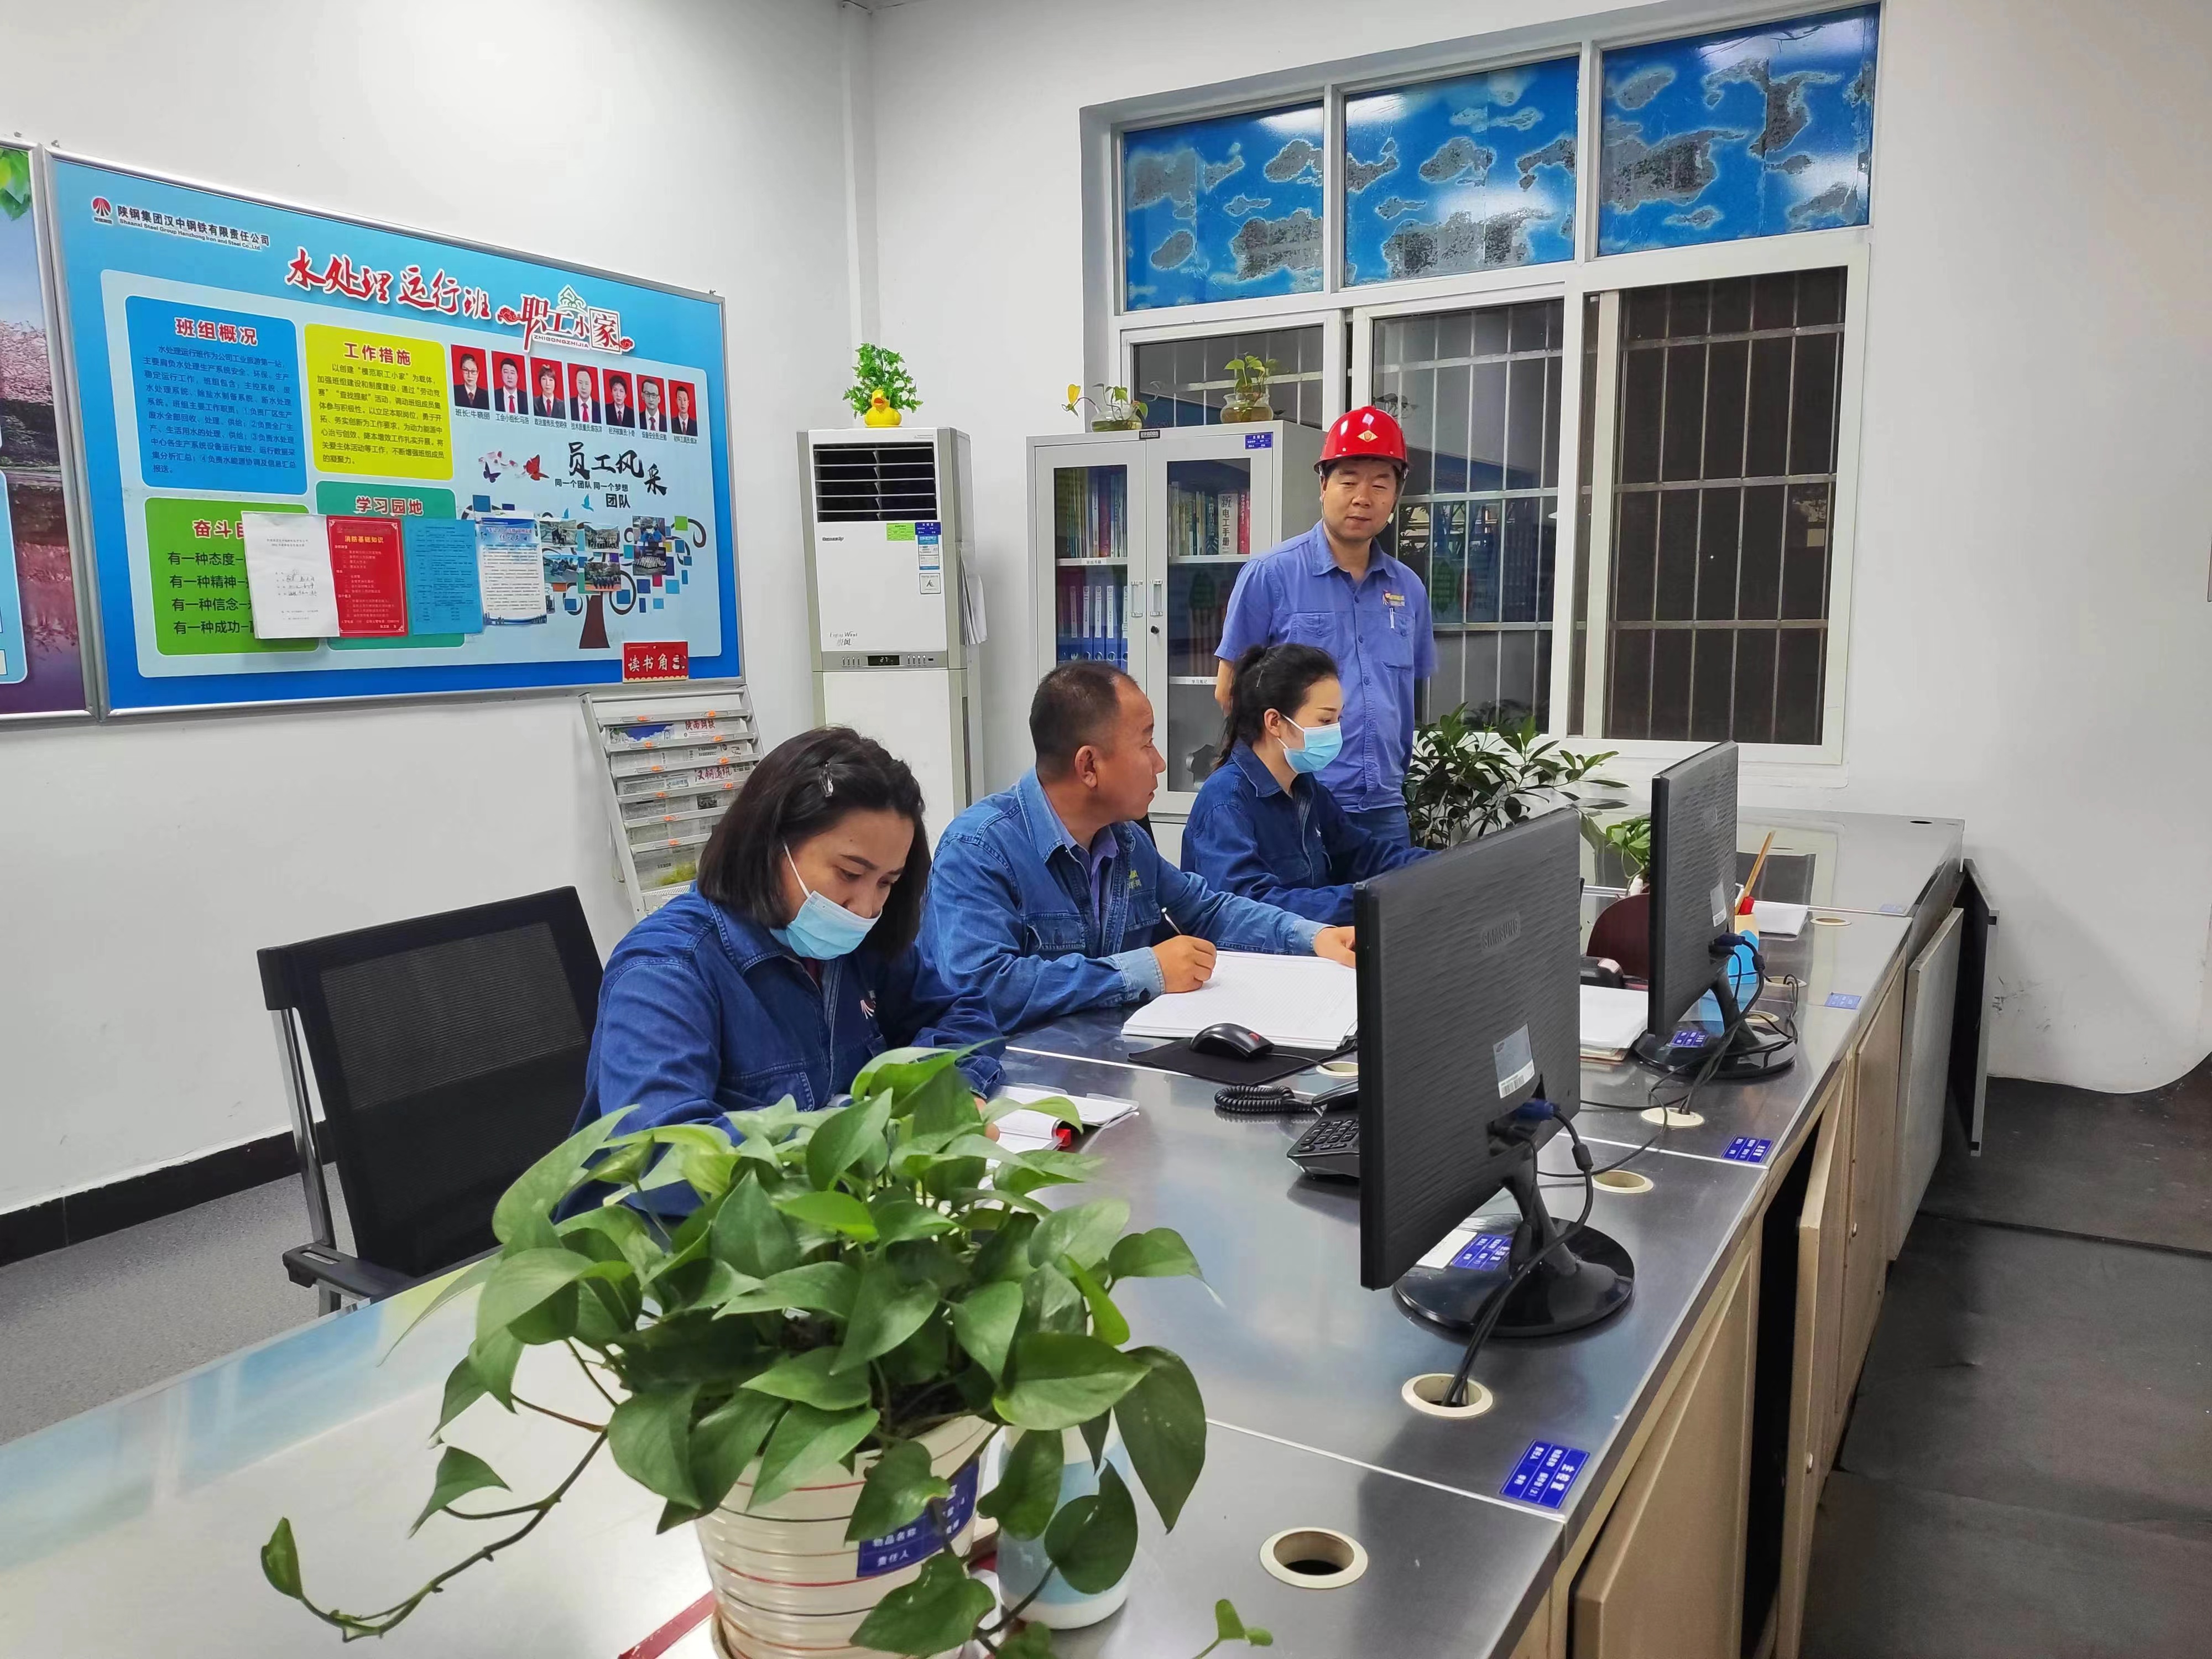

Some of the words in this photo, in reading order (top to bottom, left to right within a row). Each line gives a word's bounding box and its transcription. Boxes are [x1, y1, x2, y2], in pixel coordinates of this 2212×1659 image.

[118, 205, 269, 246] 陕钢集团汉中钢铁有限责任公司
[119, 218, 143, 227] Shaanxi
[144, 223, 158, 231] Steel
[160, 227, 177, 235] Group
[286, 249, 491, 317] 水处理运行班
[175, 317, 257, 346] 班组概况
[521, 295, 619, 351] 职工小家
[344, 342, 411, 366] 工作措施
[568, 441, 668, 496] 员工风采
[555, 478, 592, 490] 同一个团队
[593, 481, 629, 493] 同一个梦想
[356, 496, 423, 515] 学习园地
[606, 493, 631, 509] 团队
[1221, 495, 1232, 546] 新电工手册
[628, 653, 668, 672] 读书角
[1482, 918, 1520, 949] SAMSUNG
